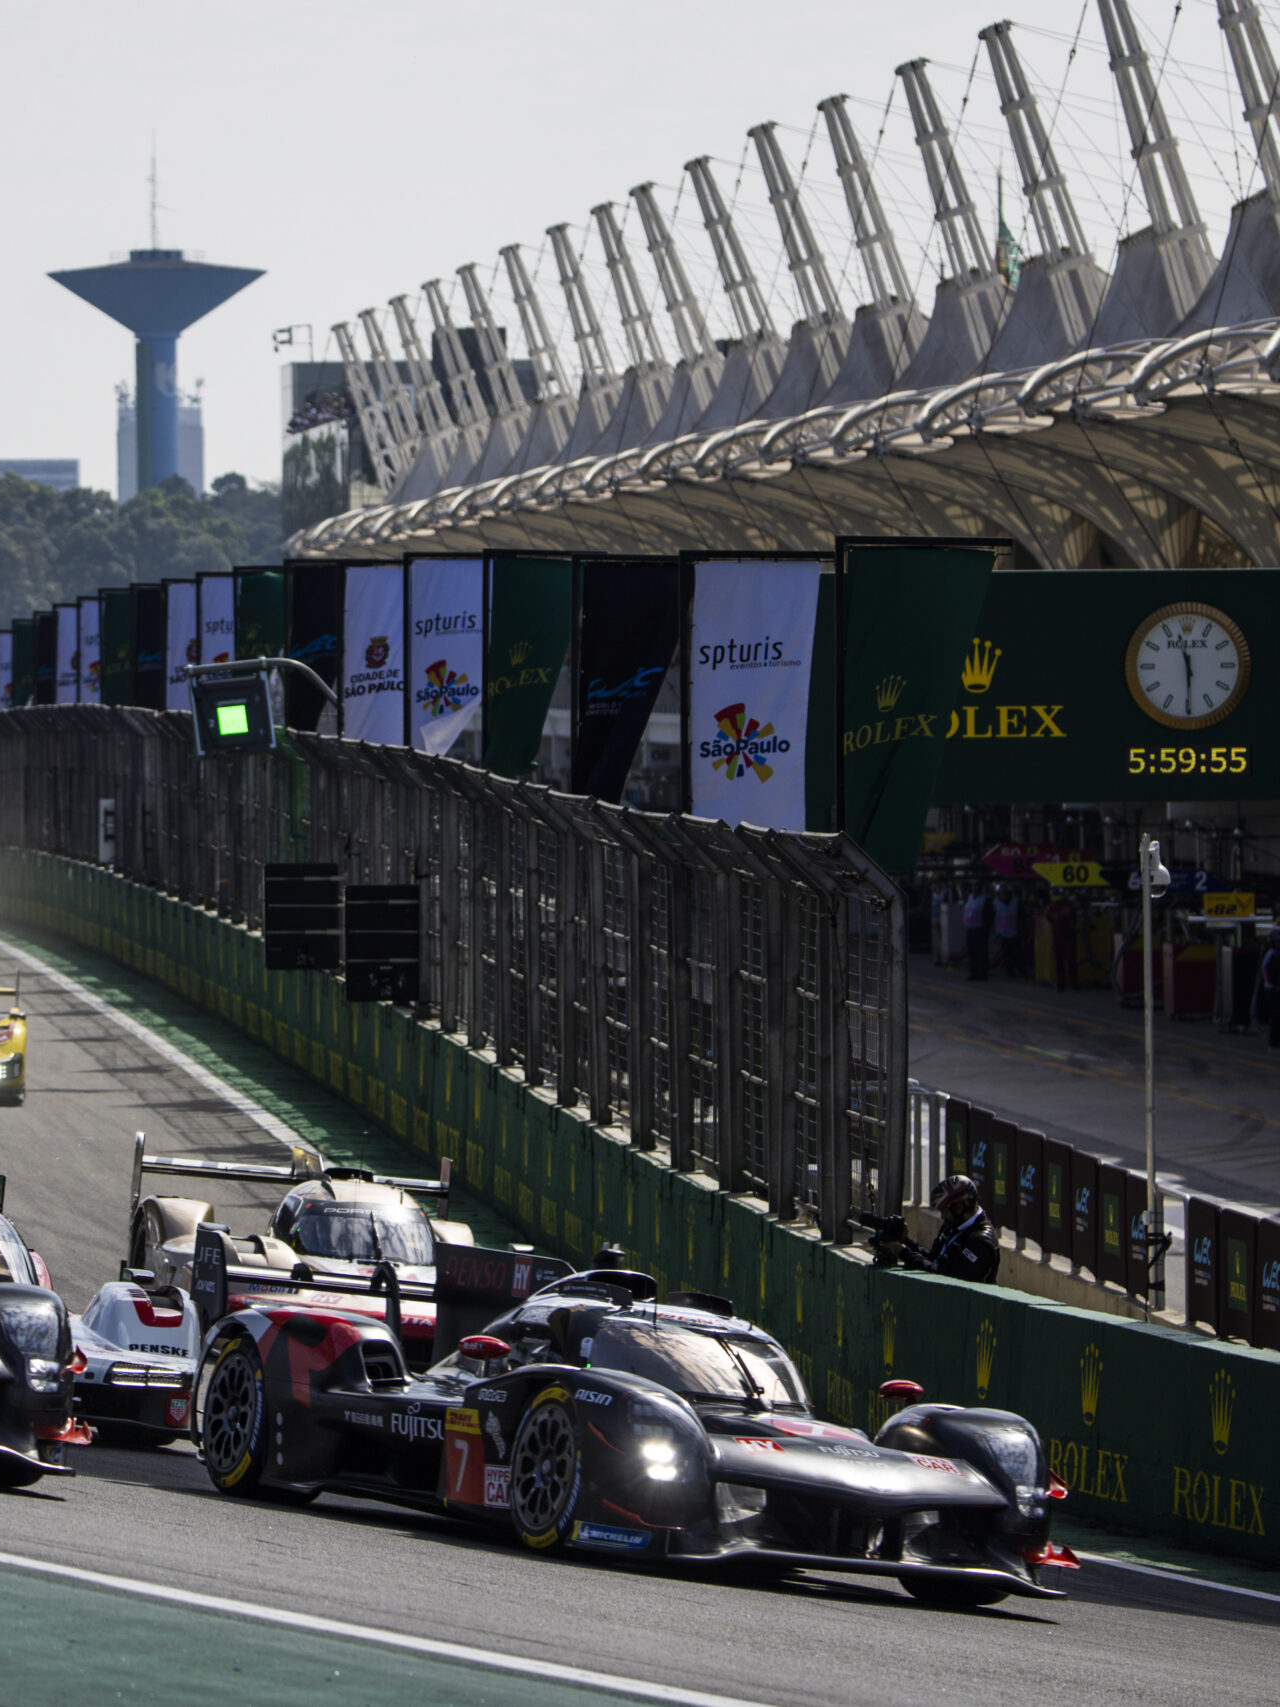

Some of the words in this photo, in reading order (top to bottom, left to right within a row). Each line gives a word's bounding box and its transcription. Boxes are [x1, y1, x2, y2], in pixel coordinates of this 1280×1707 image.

[205, 618, 234, 634] sptu
[415, 611, 477, 638] spturis
[699, 636, 784, 670] spturis
[344, 680, 365, 699] SÃO
[488, 667, 553, 698] ROLEX
[945, 705, 1067, 739] LEX
[843, 714, 938, 756] ROLEX
[1128, 747, 1247, 774] 5:59:55
[1063, 865, 1089, 883] 60
[1194, 870, 1208, 891] 2
[197, 1246, 221, 1265] JFE
[1194, 1236, 1211, 1266] WEC
[444, 1254, 507, 1291] DENSO
[513, 1262, 531, 1291] HY
[129, 1344, 190, 1358] PENSKE
[574, 1389, 613, 1407] AISIN
[738, 1439, 778, 1453] HY
[819, 1445, 880, 1459] FUJITSU
[454, 1439, 469, 1493] 7
[917, 1459, 958, 1473] CAR
[1049, 1438, 1129, 1503] ROLEX
[487, 1470, 511, 1484] HYPE
[1173, 1465, 1266, 1536] ROLEX
[591, 1529, 643, 1544] MICHELIN
